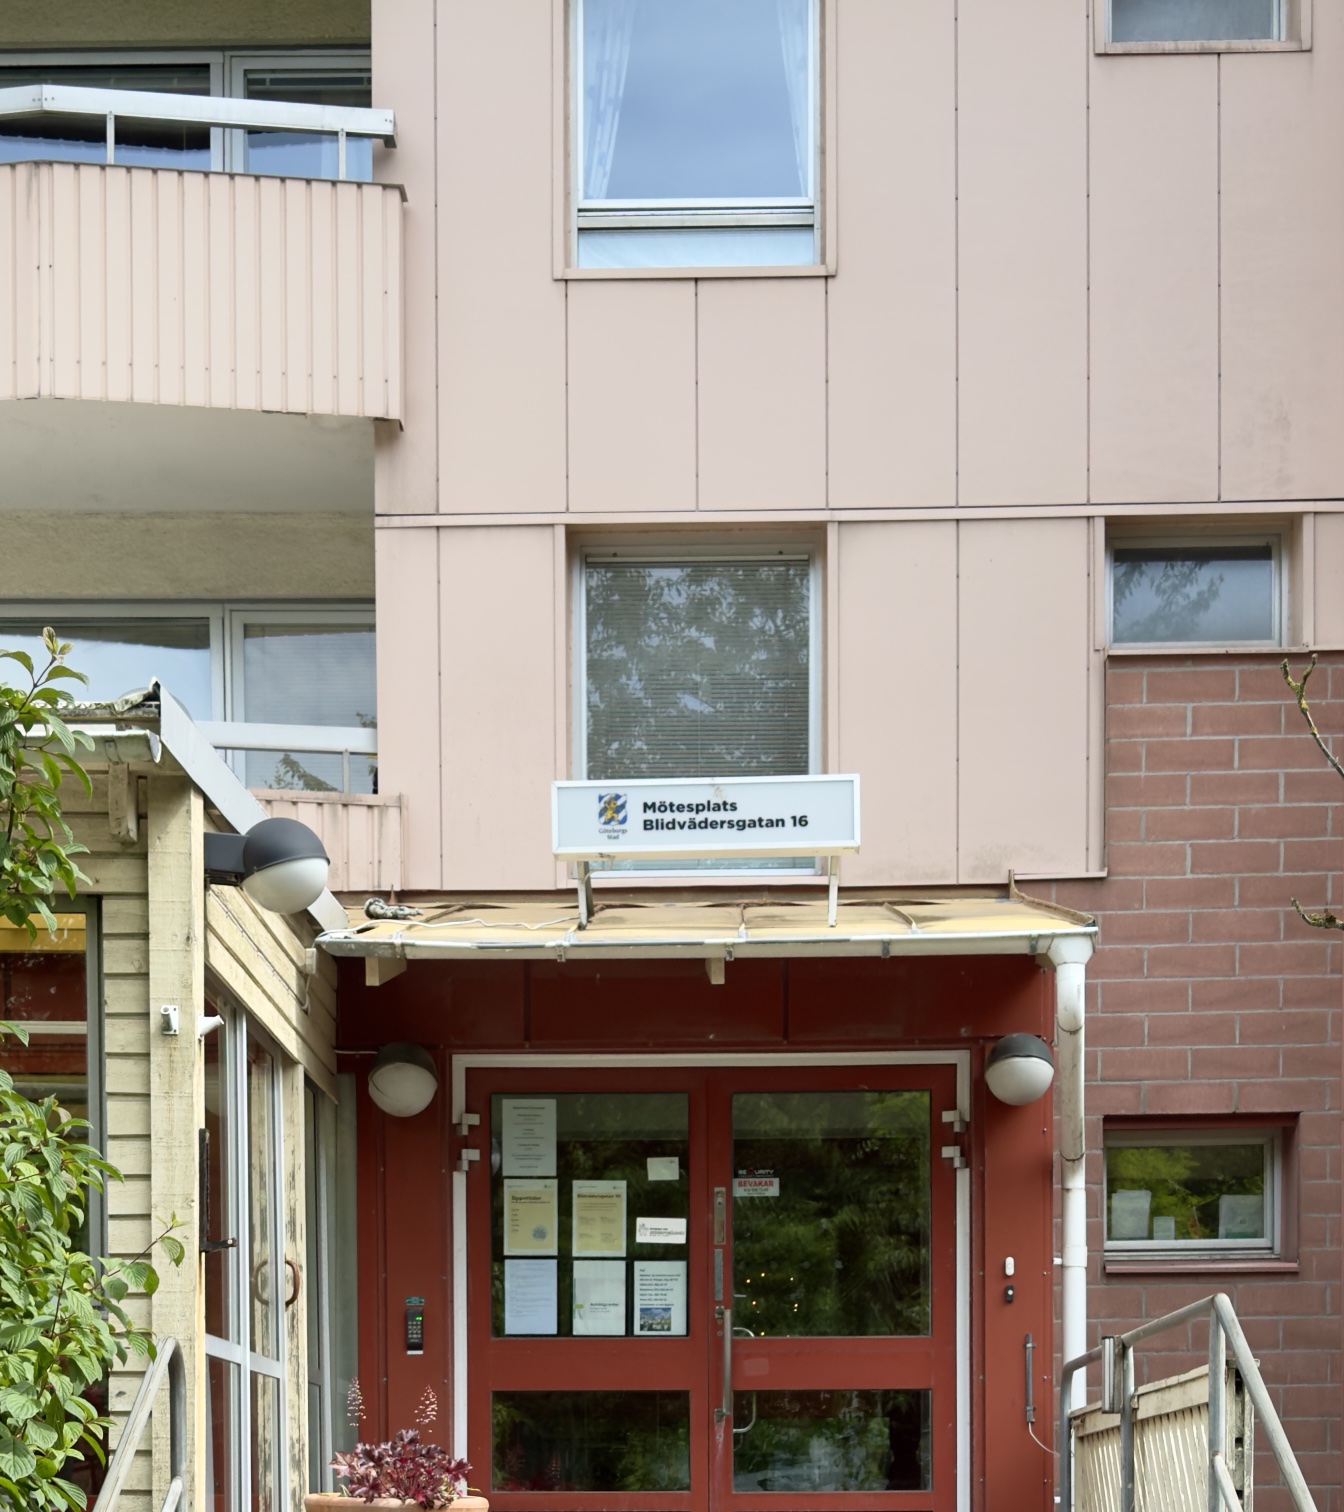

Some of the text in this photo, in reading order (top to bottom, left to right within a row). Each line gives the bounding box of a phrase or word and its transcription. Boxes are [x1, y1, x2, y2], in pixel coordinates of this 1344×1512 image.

[642, 799, 738, 815] Mötesplats
[642, 814, 809, 832] Blidvädersgatan 16
